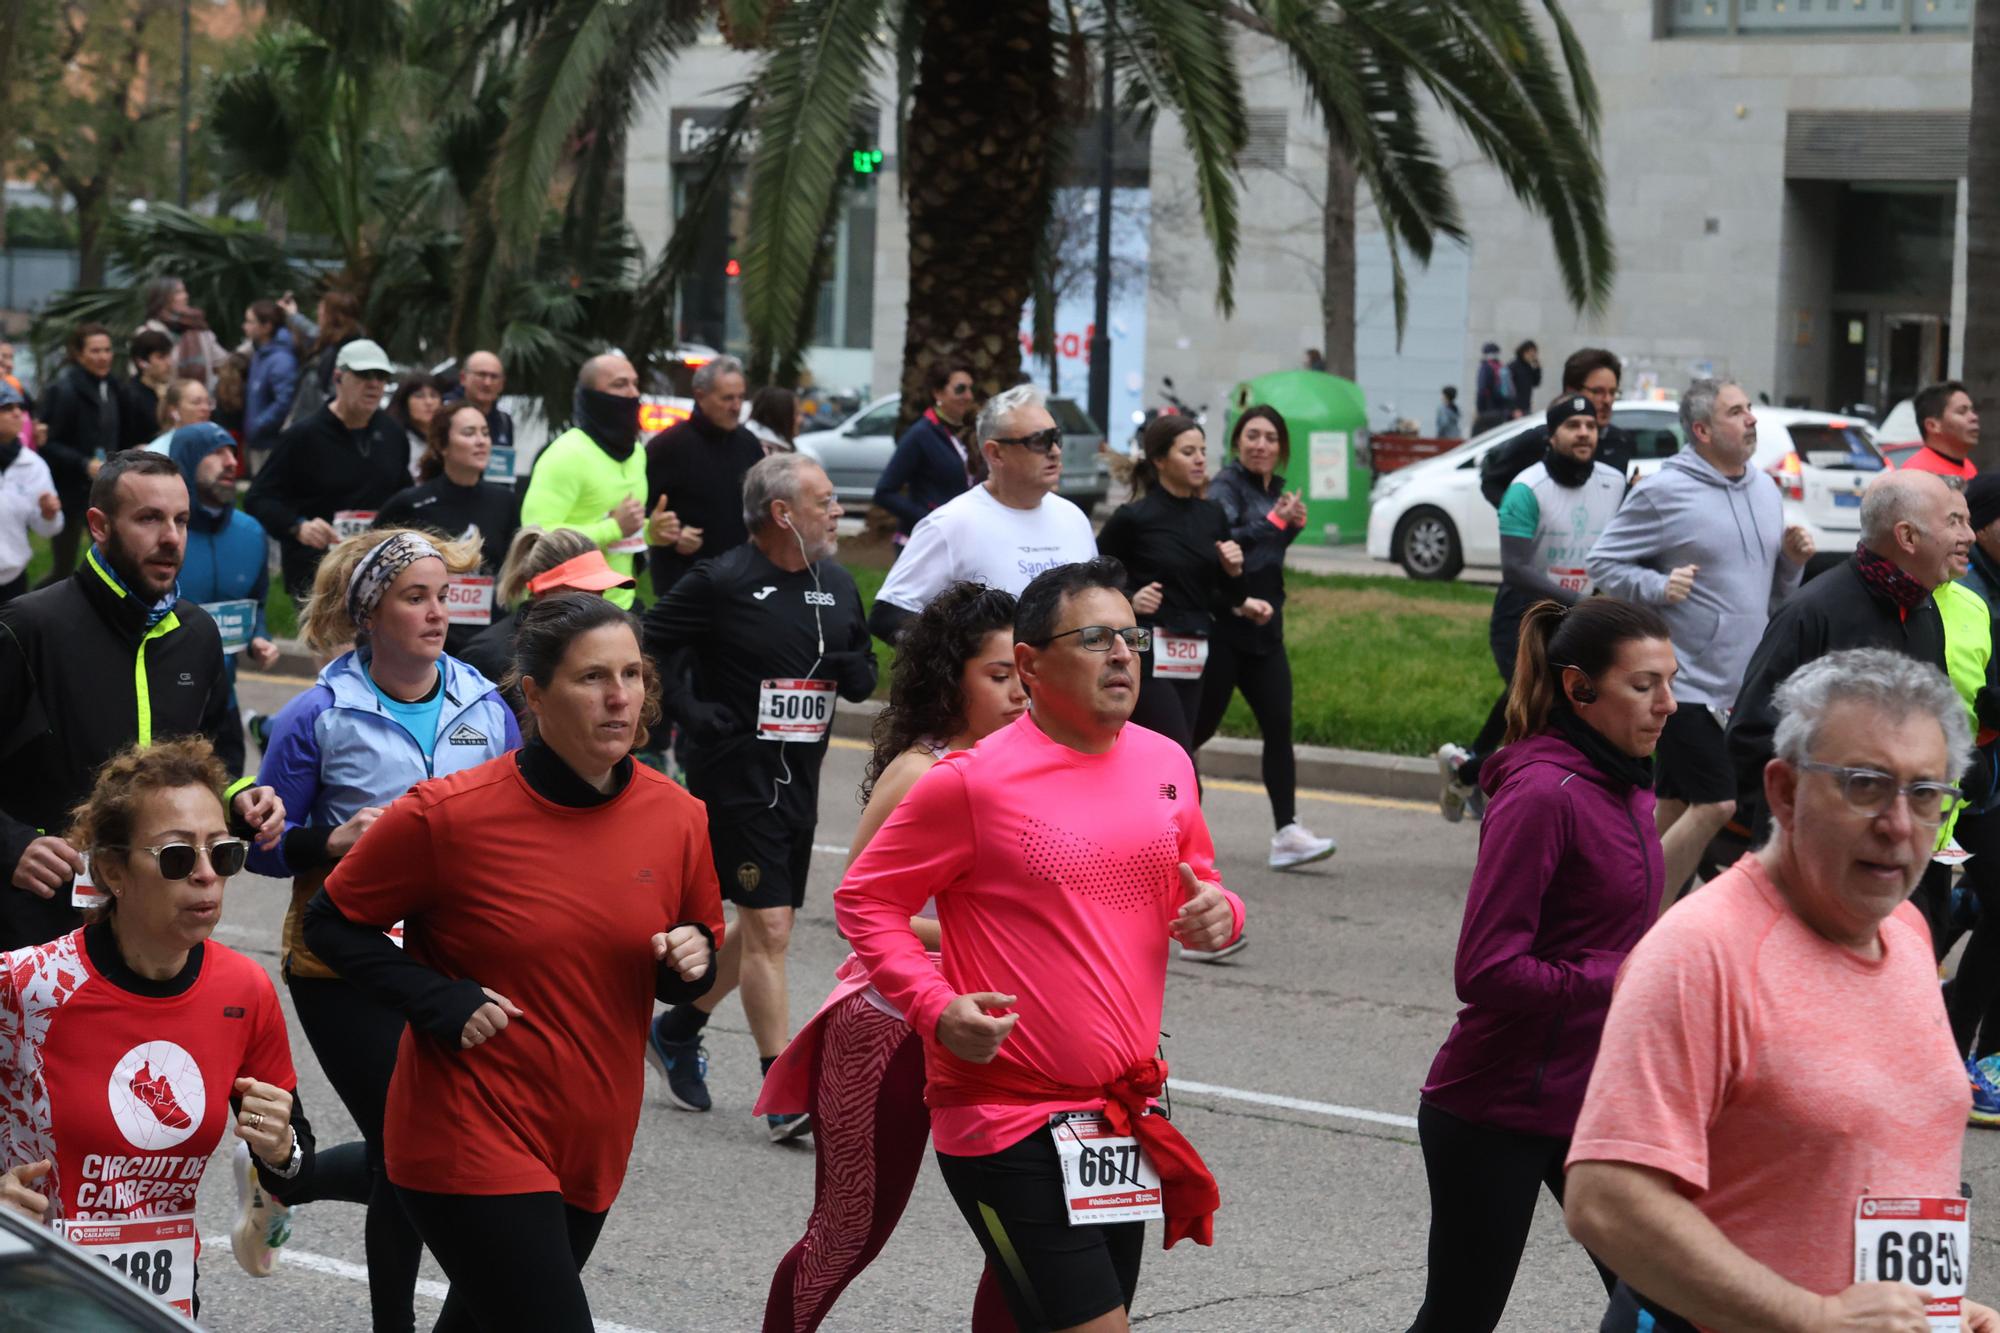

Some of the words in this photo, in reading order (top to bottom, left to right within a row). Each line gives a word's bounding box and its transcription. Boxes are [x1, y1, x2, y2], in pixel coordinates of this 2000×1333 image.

[449, 588, 482, 604] 502
[804, 591, 835, 606] ESBS
[1167, 641, 1197, 659] 520
[771, 694, 826, 720] 5006
[82, 1154, 184, 1182] CIRCUIT
[178, 1155, 209, 1180] DE
[1079, 1144, 1141, 1187] 6677
[76, 1179, 198, 1210] CARRERES
[94, 1249, 172, 1296] 188
[1877, 1231, 1962, 1286] 6859
